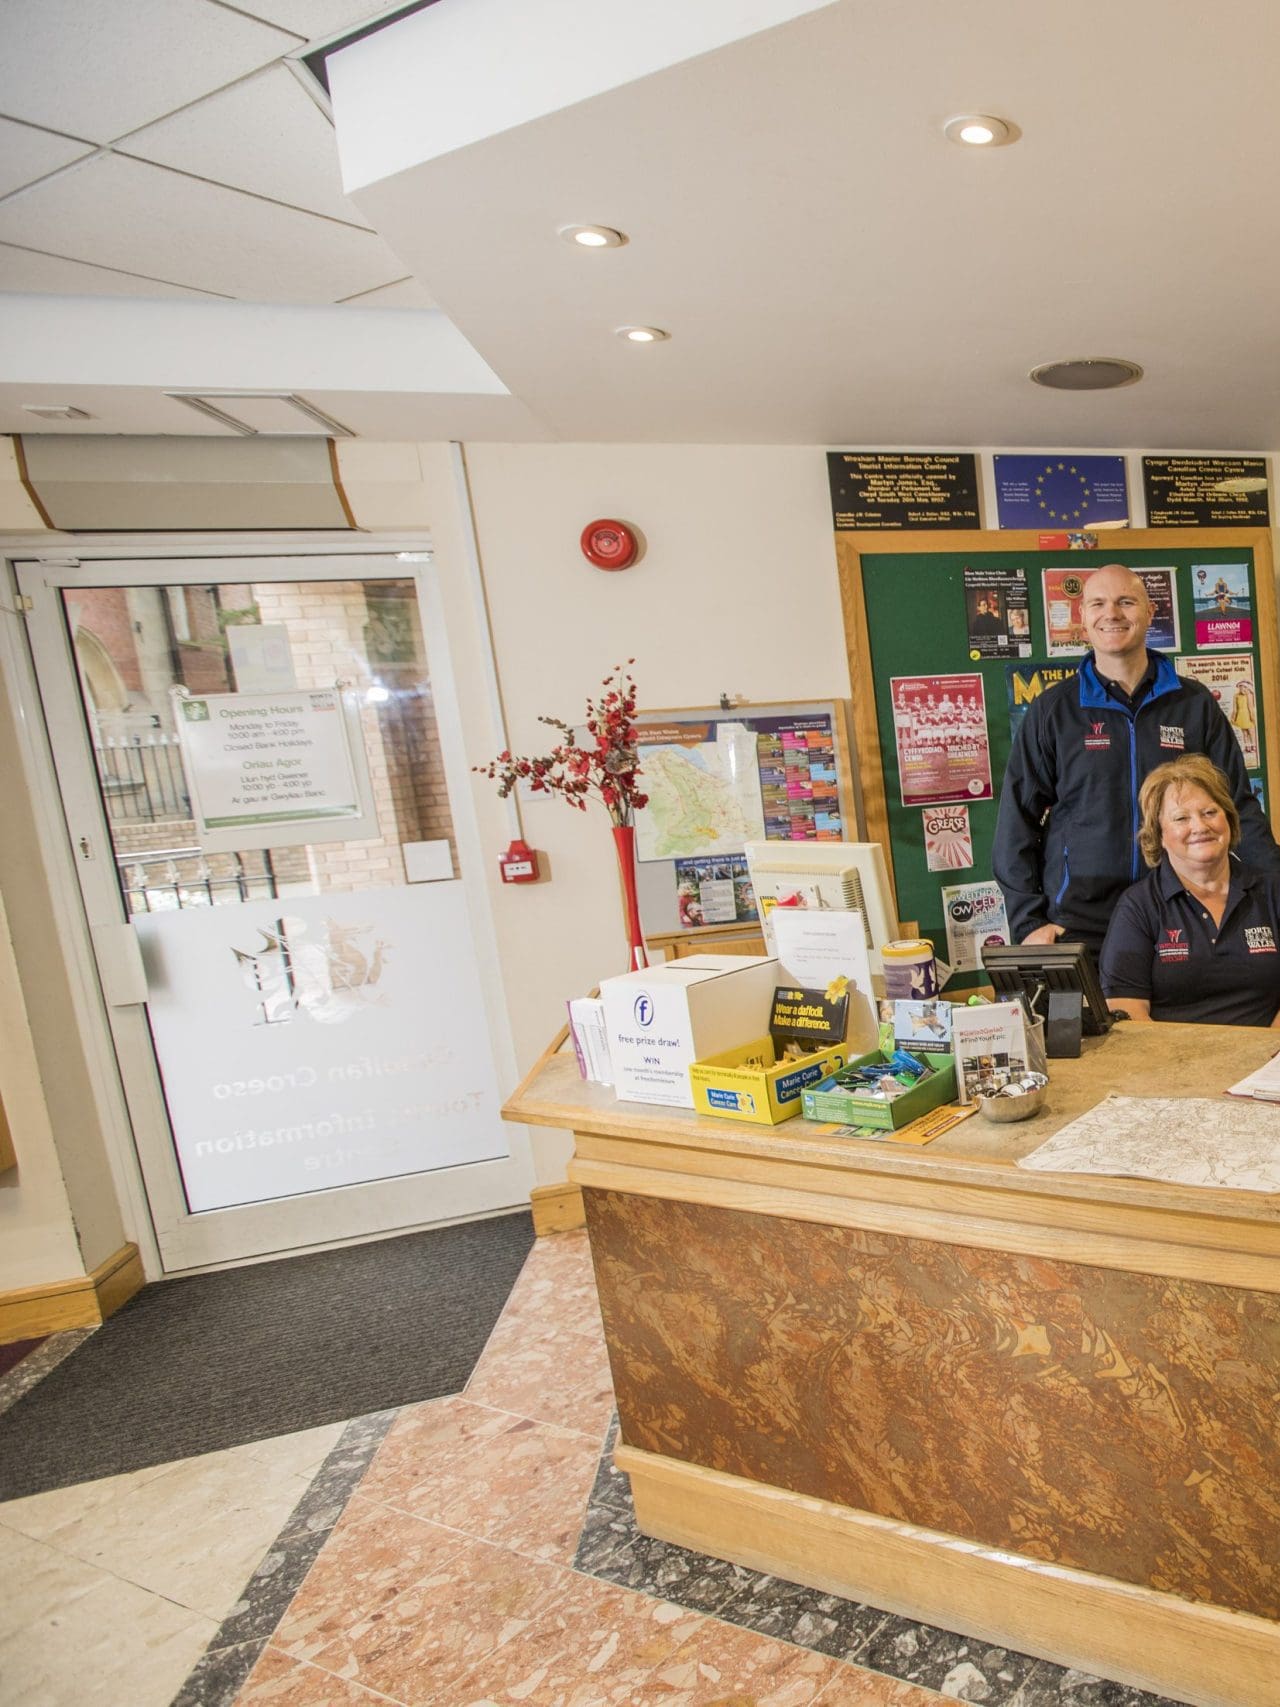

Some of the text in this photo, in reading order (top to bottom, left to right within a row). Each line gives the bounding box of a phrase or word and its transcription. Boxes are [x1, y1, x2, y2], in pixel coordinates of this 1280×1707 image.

[1208, 622, 1240, 630] LLAWN04
[1042, 670, 1062, 680] THE
[219, 705, 304, 718] Opening Hours
[229, 722, 263, 730] Monday
[275, 720, 300, 730] Friday
[228, 731, 250, 740] 10:00
[291, 728, 306, 736] pm
[224, 738, 314, 752] Closed Bank Holidays
[242, 758, 302, 770] Oriau Agor
[260, 774, 276, 784] hyd
[278, 772, 308, 780] Gwener
[242, 783, 264, 792] 10:00
[305, 790, 326, 798] Banc
[926, 816, 966, 834] GREASE
[952, 905, 972, 916] OW
[1244, 926, 1272, 935] NORTH
[1248, 939, 1276, 948] WALES
[639, 1000, 648, 1022] f
[776, 1003, 792, 1015] Wear
[798, 1005, 824, 1018] daffodil.
[774, 1014, 831, 1030] Make a difference.
[618, 1034, 680, 1048] free prize draw!
[960, 1034, 1006, 1044] #FindYourEpic
[643, 1056, 660, 1064] WIN
[782, 1068, 818, 1088] Marie Curie
[711, 1091, 736, 1100] Marie Curie
[711, 1098, 738, 1108] Cancer Care
